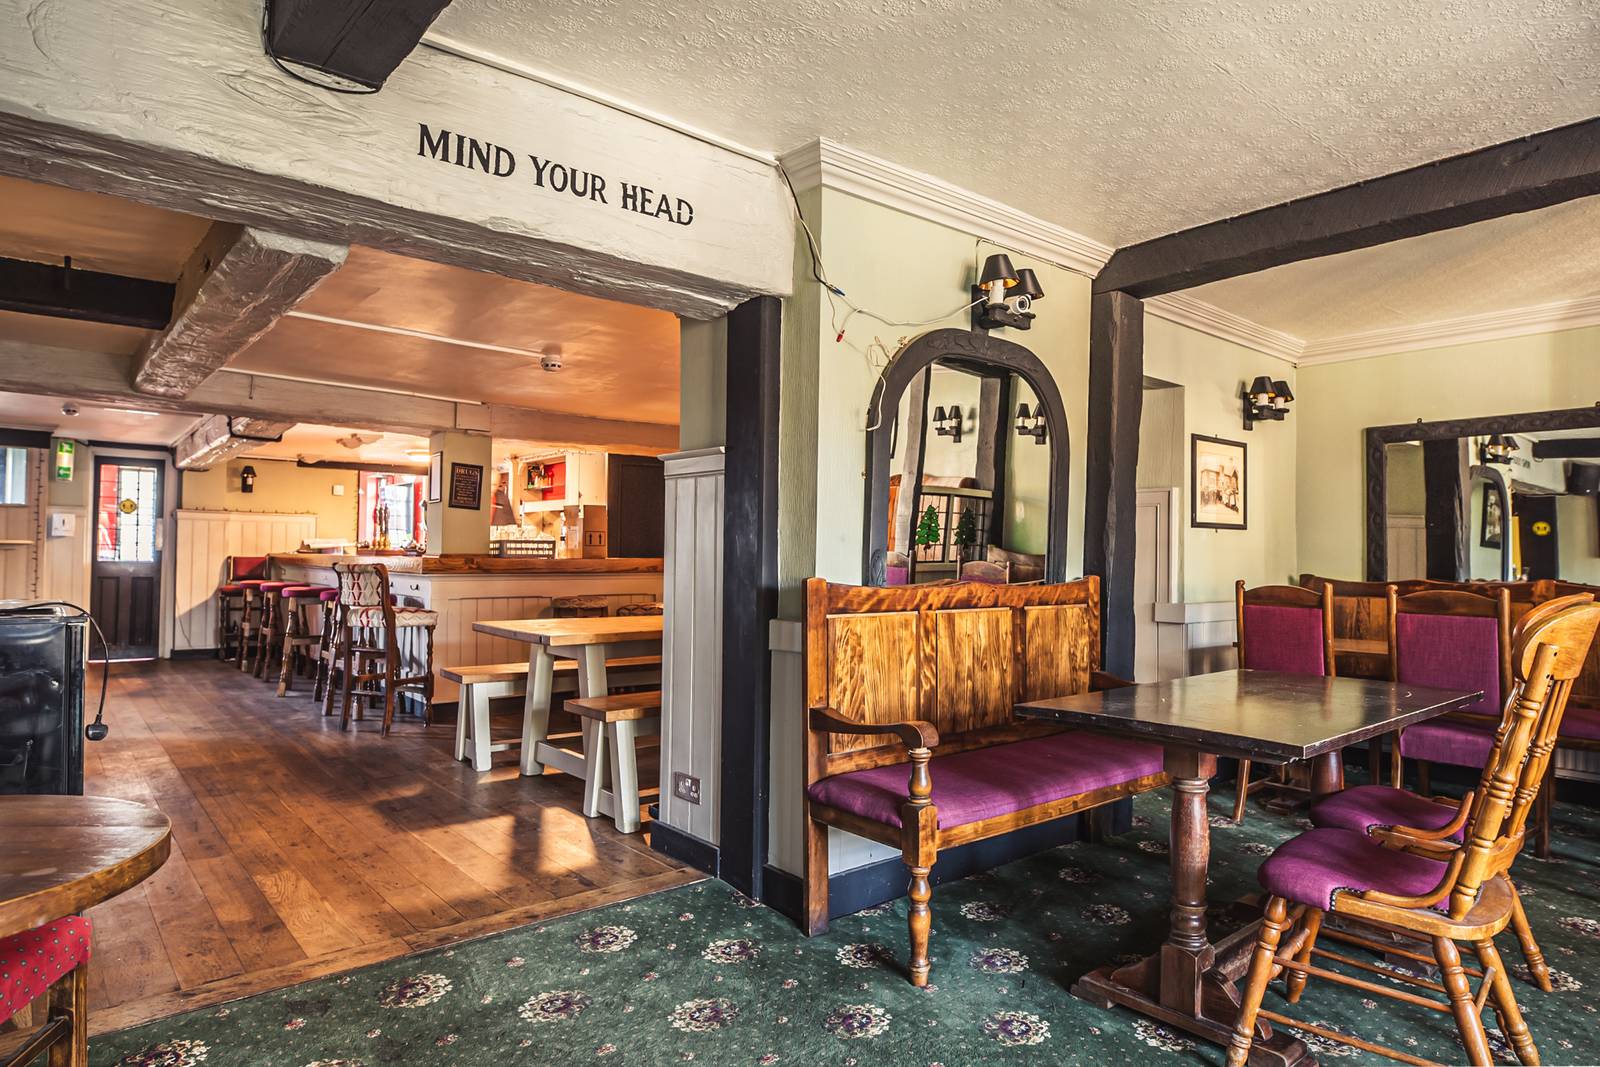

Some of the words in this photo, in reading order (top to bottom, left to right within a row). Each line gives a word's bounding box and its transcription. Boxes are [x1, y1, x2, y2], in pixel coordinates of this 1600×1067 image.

[417, 122, 516, 177] MIND
[528, 154, 608, 204] YOUR
[619, 181, 694, 226] HEAD
[456, 467, 479, 475] DRUGS
